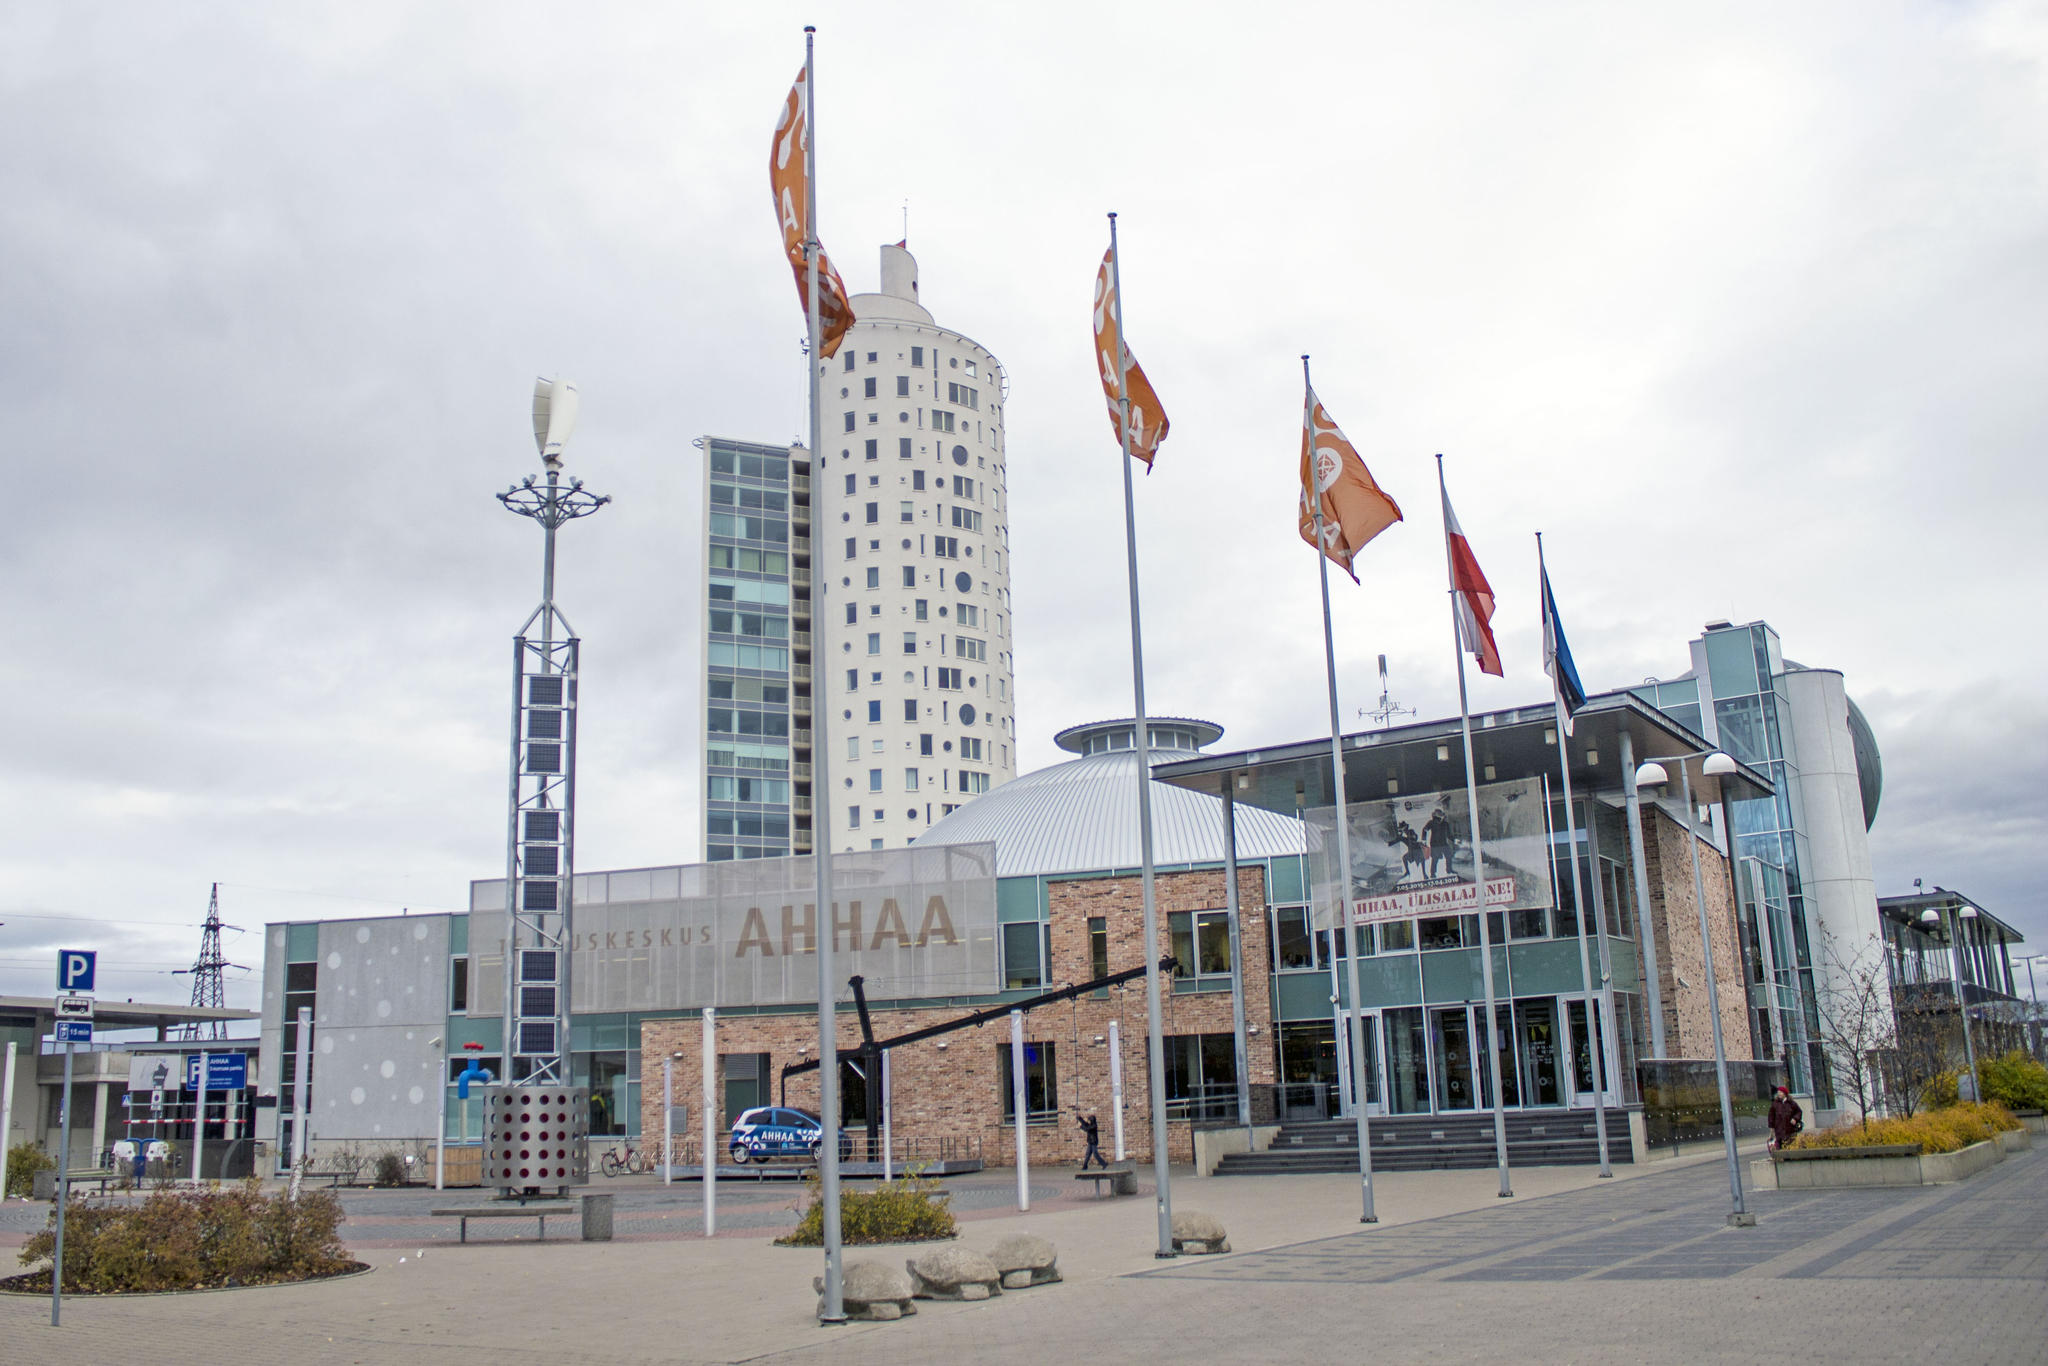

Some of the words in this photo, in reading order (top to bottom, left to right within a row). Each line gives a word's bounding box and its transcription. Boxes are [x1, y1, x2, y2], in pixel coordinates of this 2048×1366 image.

[1408, 881, 1512, 908] ÜLISALAJNE!
[735, 895, 959, 958] AHHAA
[67, 954, 88, 987] P
[761, 1130, 795, 1142] AHHAA
